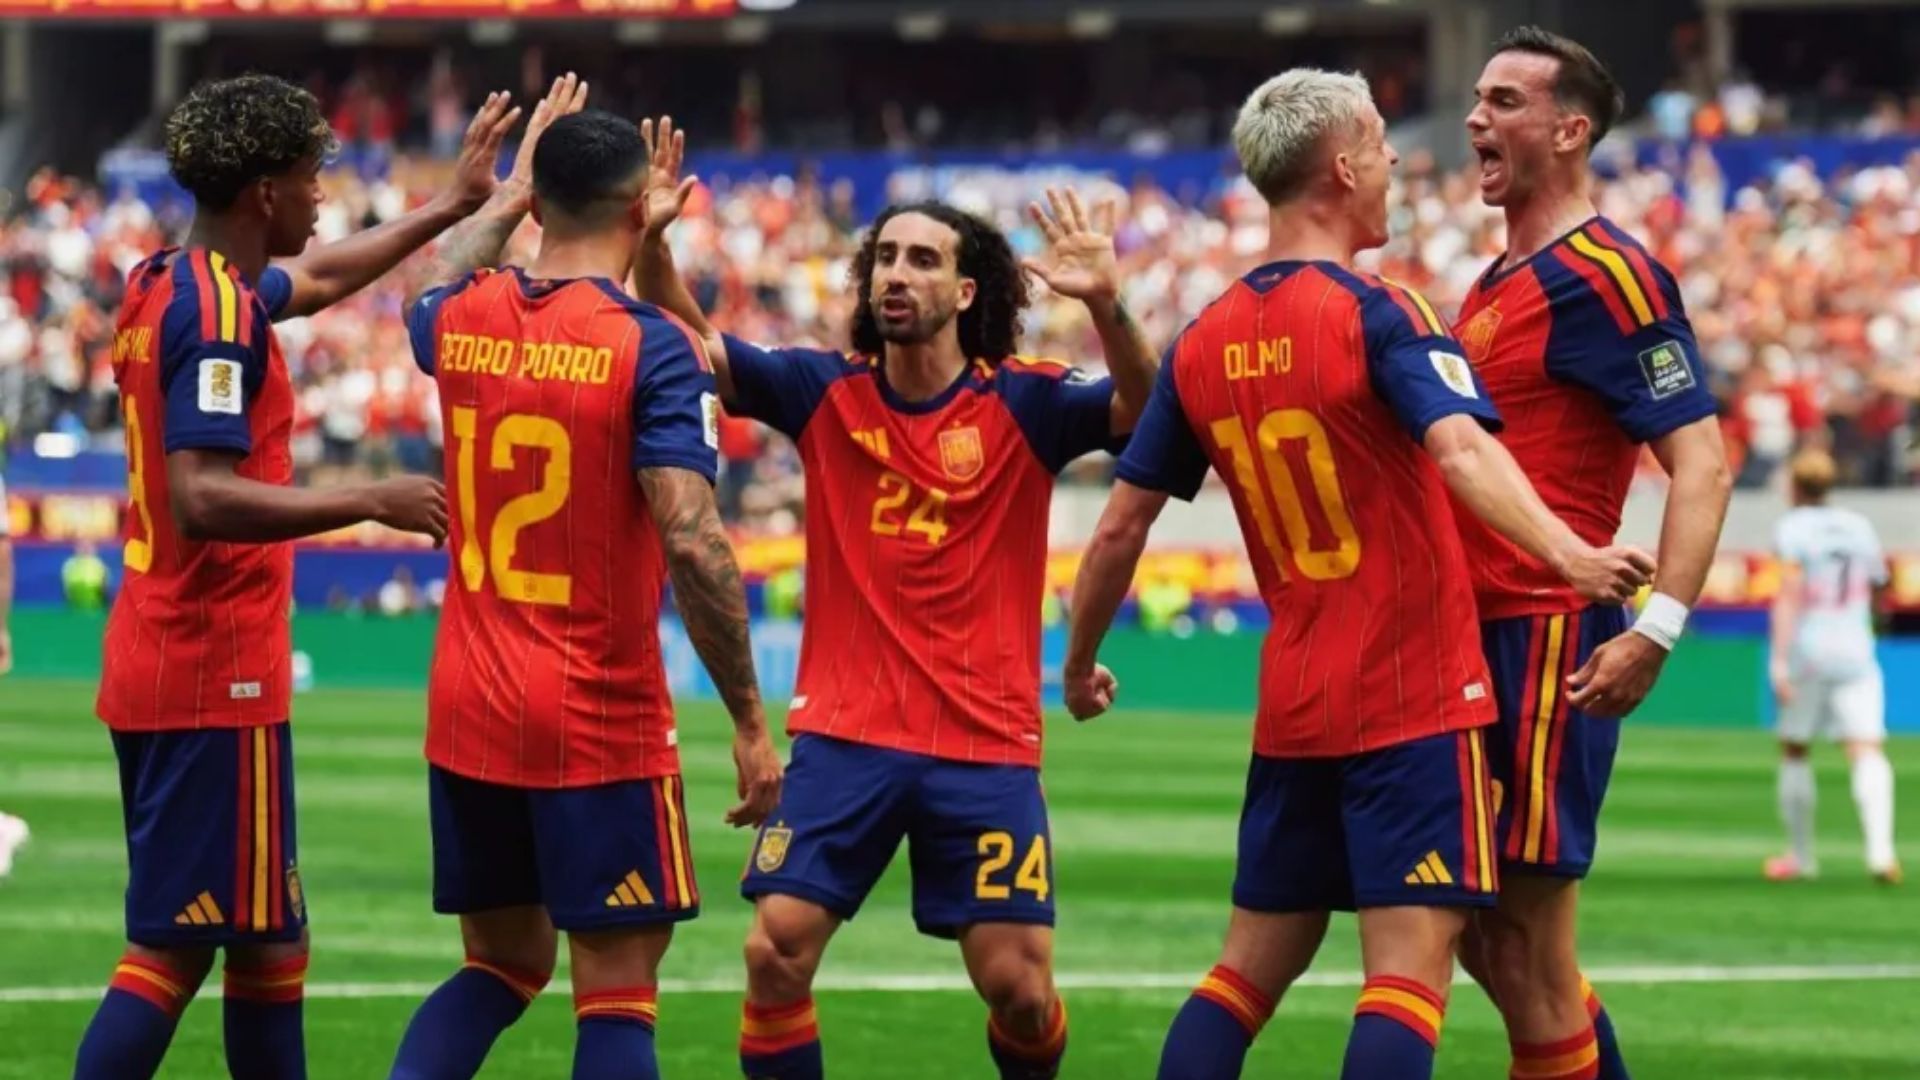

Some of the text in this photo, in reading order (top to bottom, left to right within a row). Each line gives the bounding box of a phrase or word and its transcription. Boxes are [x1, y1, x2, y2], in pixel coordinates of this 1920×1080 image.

[441, 332, 613, 384] PEDRO PORRO
[1223, 336, 1292, 380] OLMO
[451, 404, 572, 607] 12
[870, 470, 949, 546] 24
[1209, 408, 1361, 583] 10
[975, 830, 1049, 903] 24
